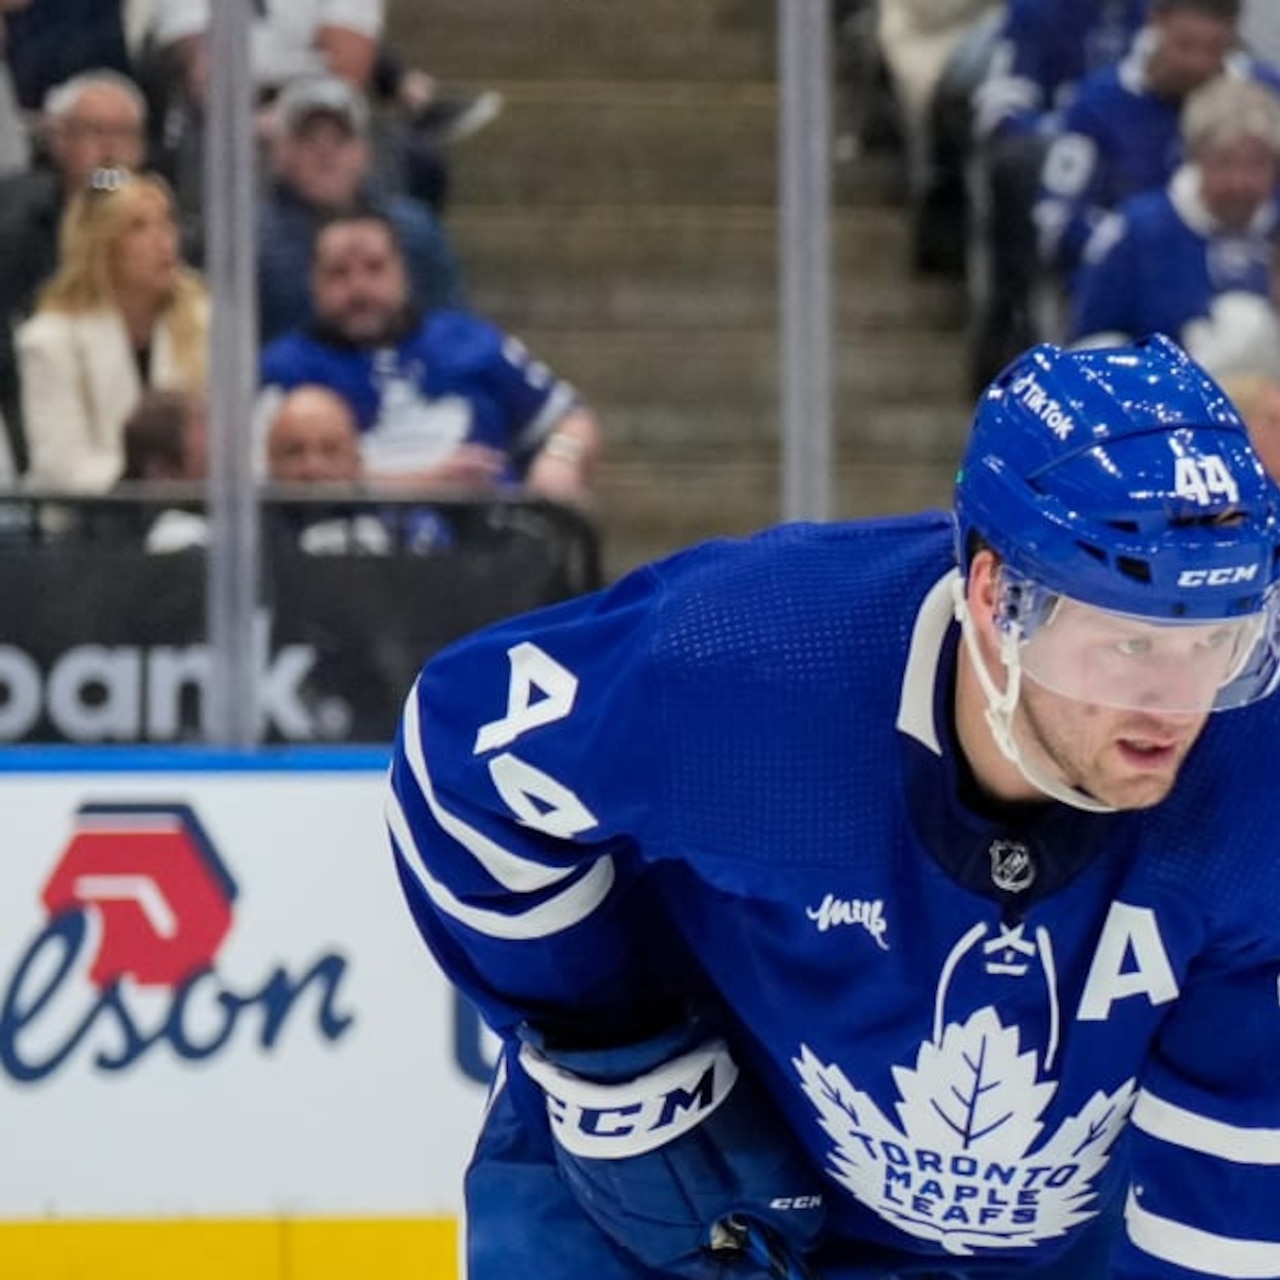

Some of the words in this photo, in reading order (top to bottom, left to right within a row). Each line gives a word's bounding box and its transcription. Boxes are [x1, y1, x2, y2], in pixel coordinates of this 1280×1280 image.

[1022, 380, 1075, 441] TikTok
[1174, 455, 1239, 506] 44
[1177, 564, 1259, 588] CCM
[1076, 901, 1179, 1022] A
[849, 1130, 1080, 1189] TORONTO
[883, 1183, 1038, 1226] LEAFS
[885, 1164, 1041, 1207] MAPLE
